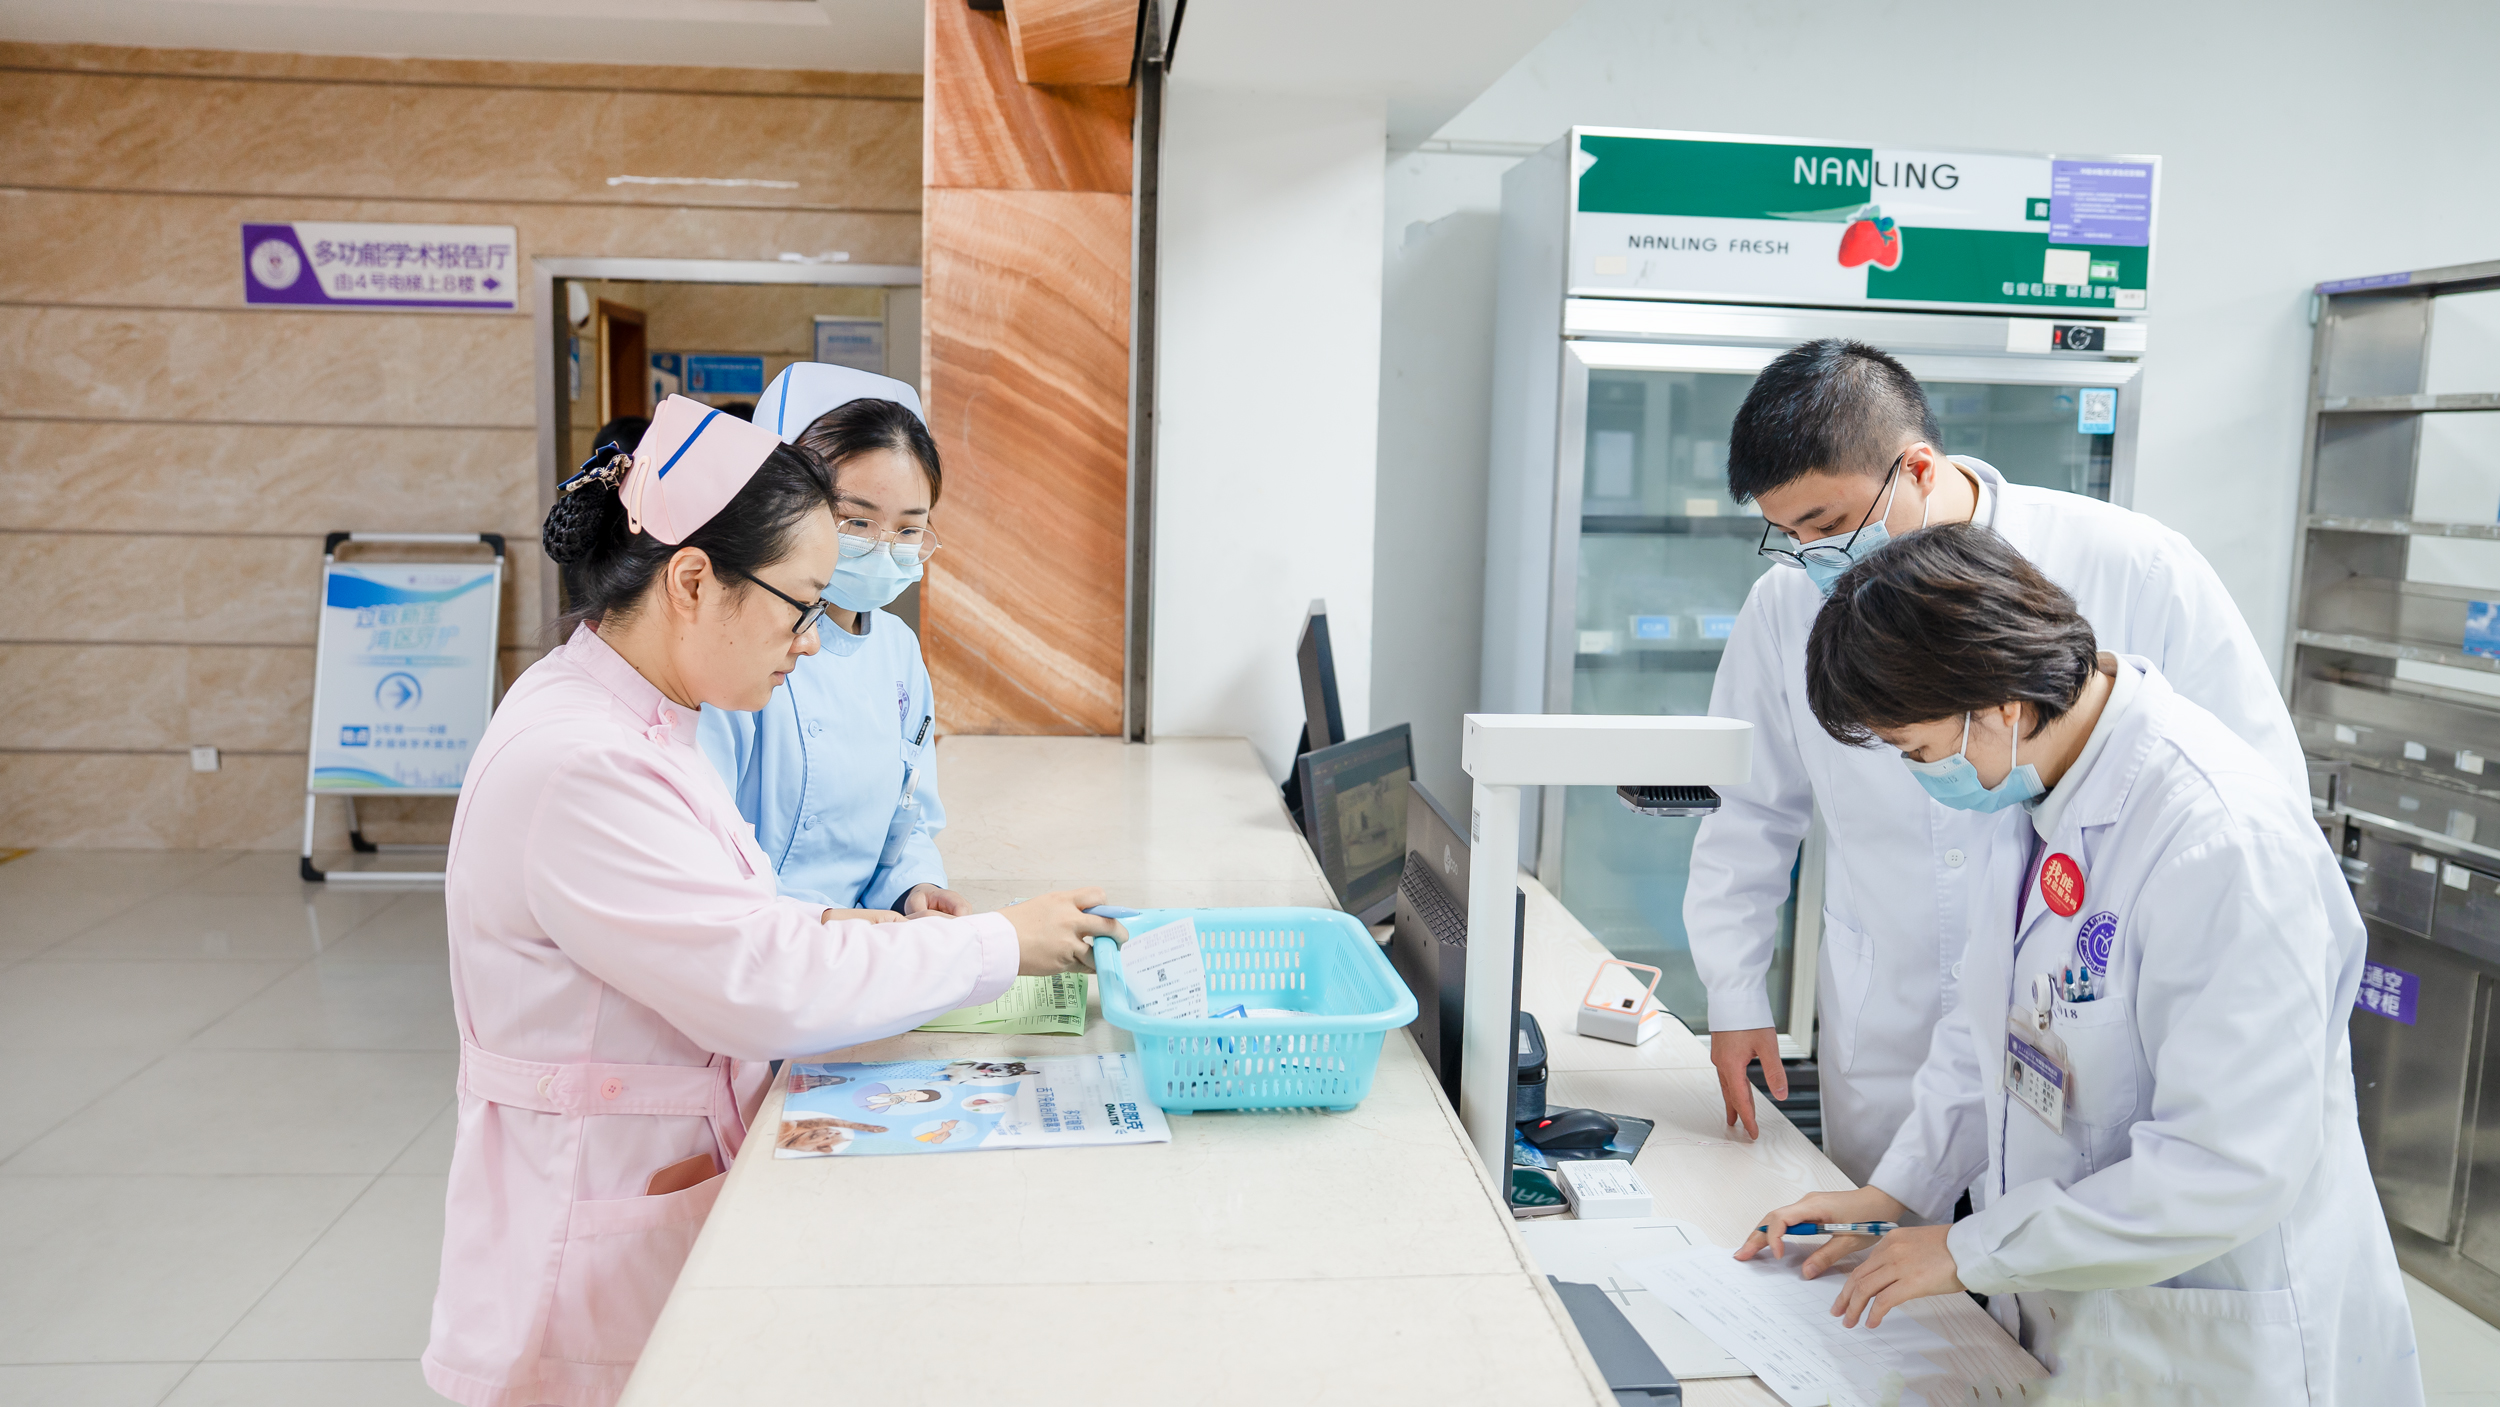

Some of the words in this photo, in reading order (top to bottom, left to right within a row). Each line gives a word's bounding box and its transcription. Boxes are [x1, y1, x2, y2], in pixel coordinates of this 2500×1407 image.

[1793, 155, 1960, 190] NANLING
[314, 240, 511, 271] 多功能学术报告厅
[1628, 234, 1717, 252] NANLING
[1728, 238, 1790, 255] FRESH
[2043, 859, 2075, 894] 我能
[1062, 1109, 1085, 1131] 多过敏原
